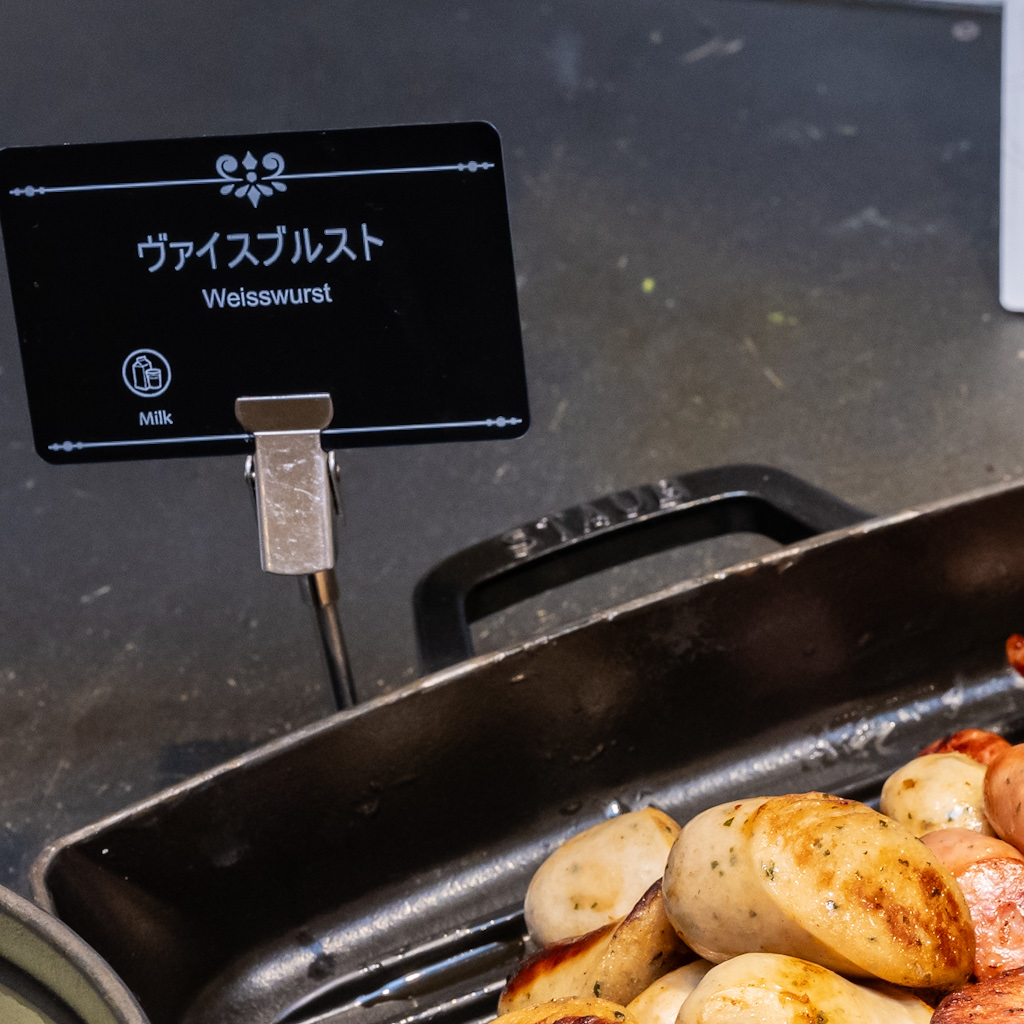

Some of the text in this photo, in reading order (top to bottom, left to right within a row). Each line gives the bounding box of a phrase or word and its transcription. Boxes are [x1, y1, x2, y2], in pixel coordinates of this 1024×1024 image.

[137, 223, 385, 273] ヴァイスブルスト
[202, 283, 333, 309] Weisswurst
[139, 410, 173, 426] Milk
